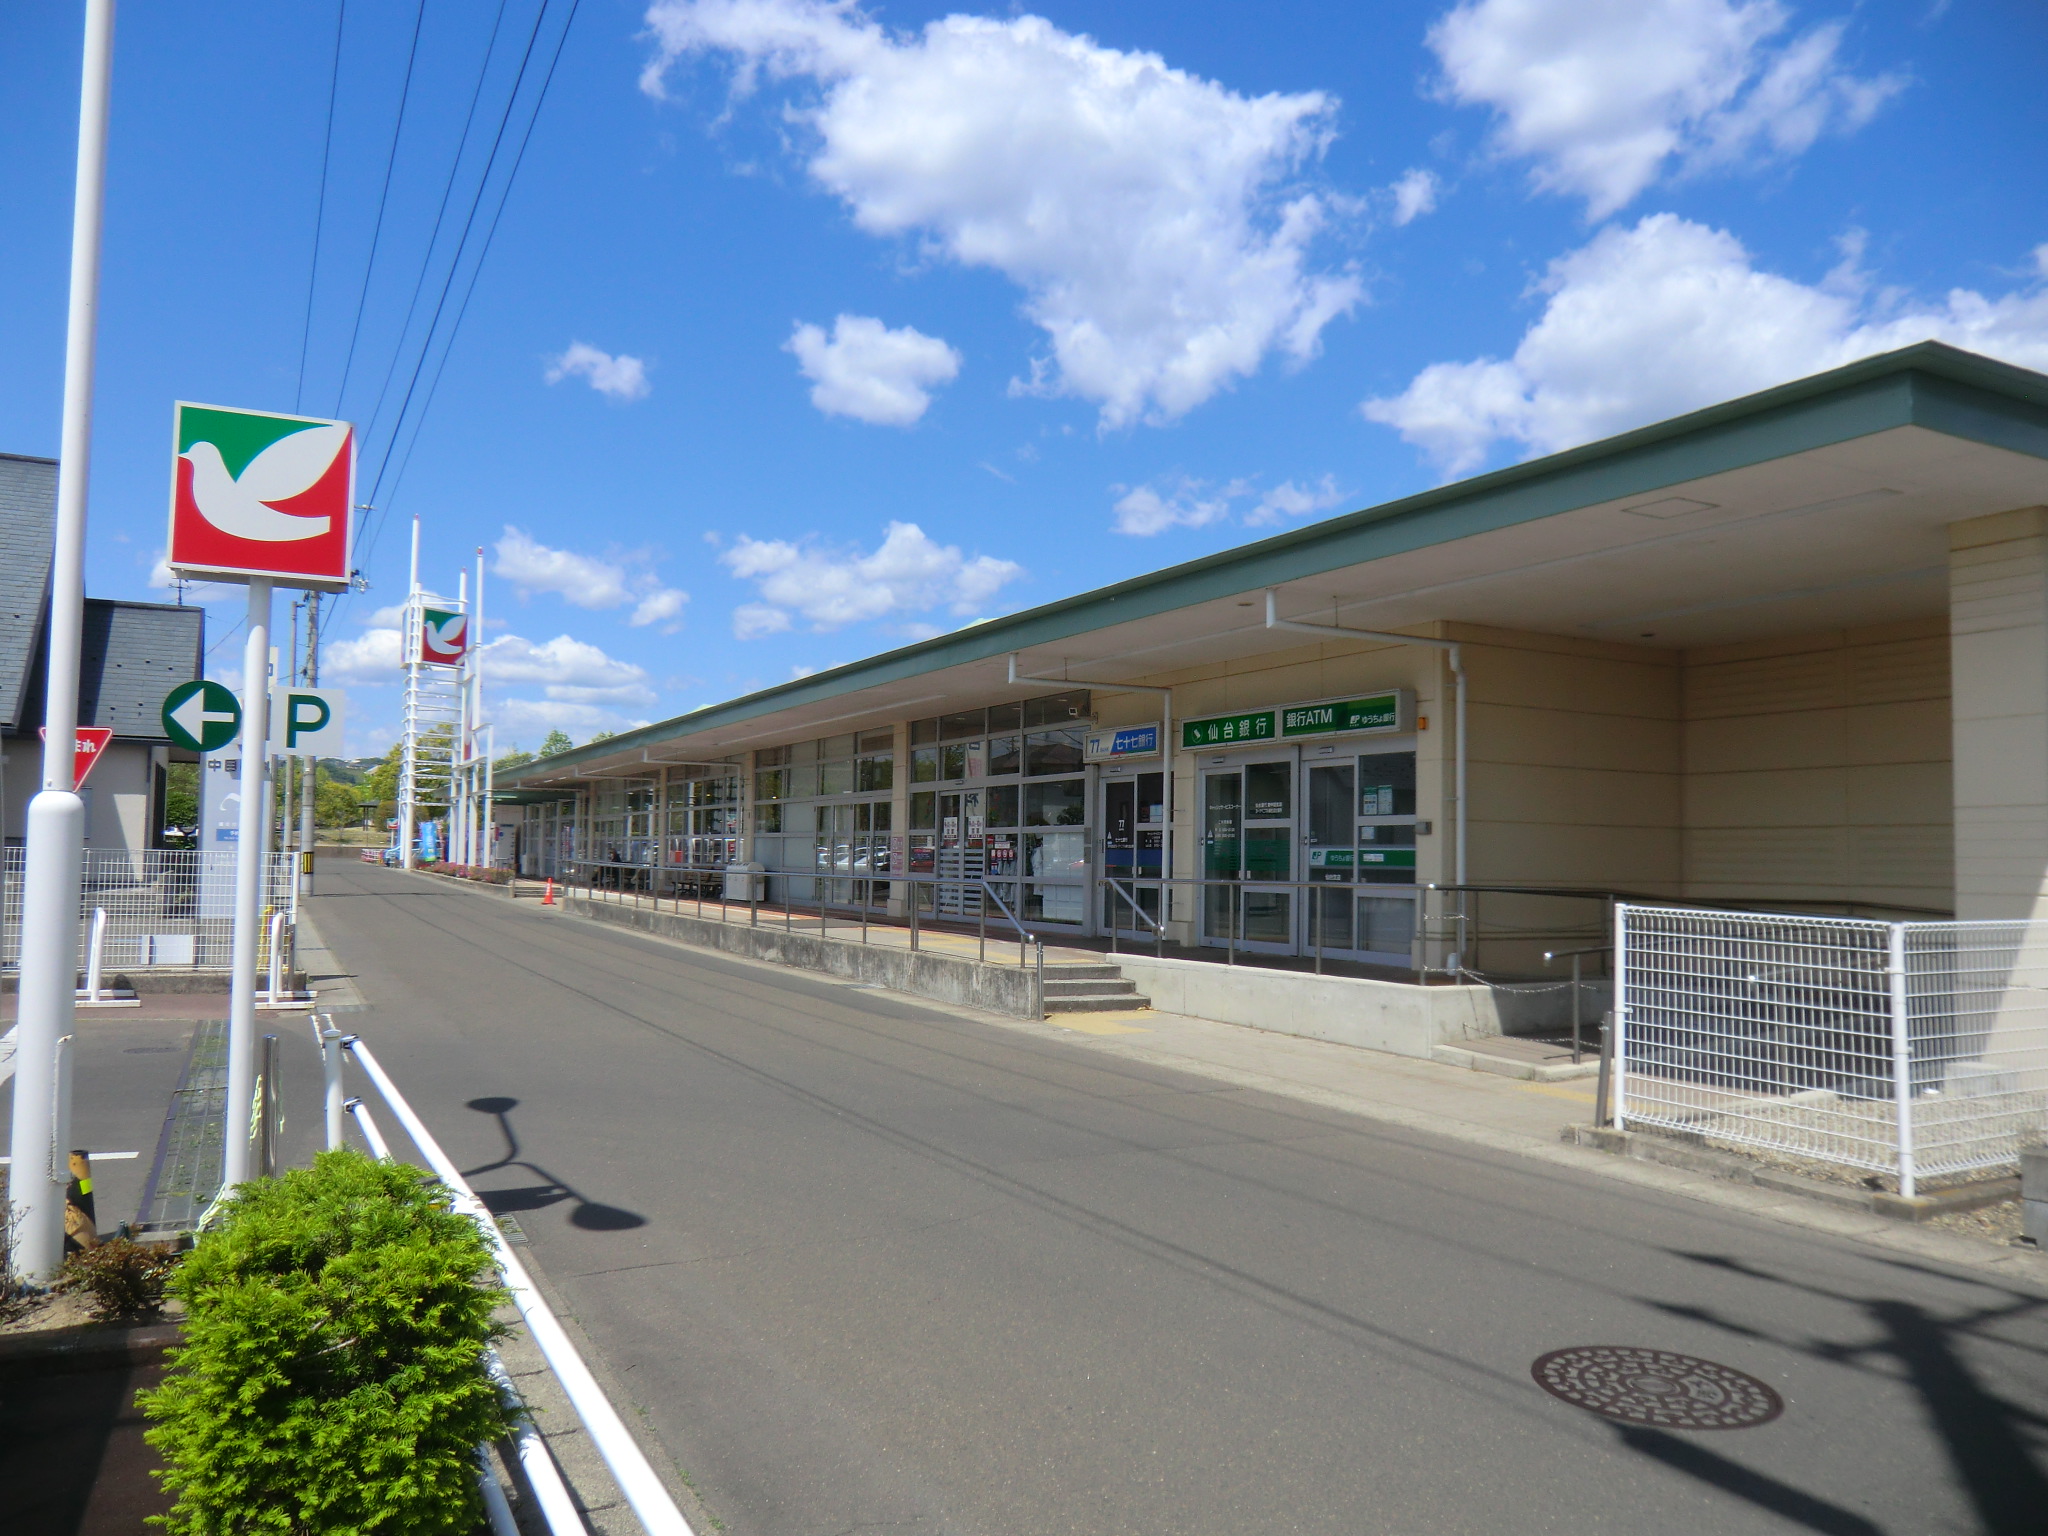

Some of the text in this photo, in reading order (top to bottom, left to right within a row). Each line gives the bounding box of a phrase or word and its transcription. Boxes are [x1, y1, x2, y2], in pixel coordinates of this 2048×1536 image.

[286, 694, 330, 748] P
[1286, 708, 1333, 728] 銀行ATM
[1362, 712, 1395, 724] ゆうちょ銀行
[1208, 717, 1267, 741] 仙台銀行
[75, 739, 97, 753] まれ
[1090, 738, 1100, 753] 77
[1115, 733, 1153, 751] 七十七銀行
